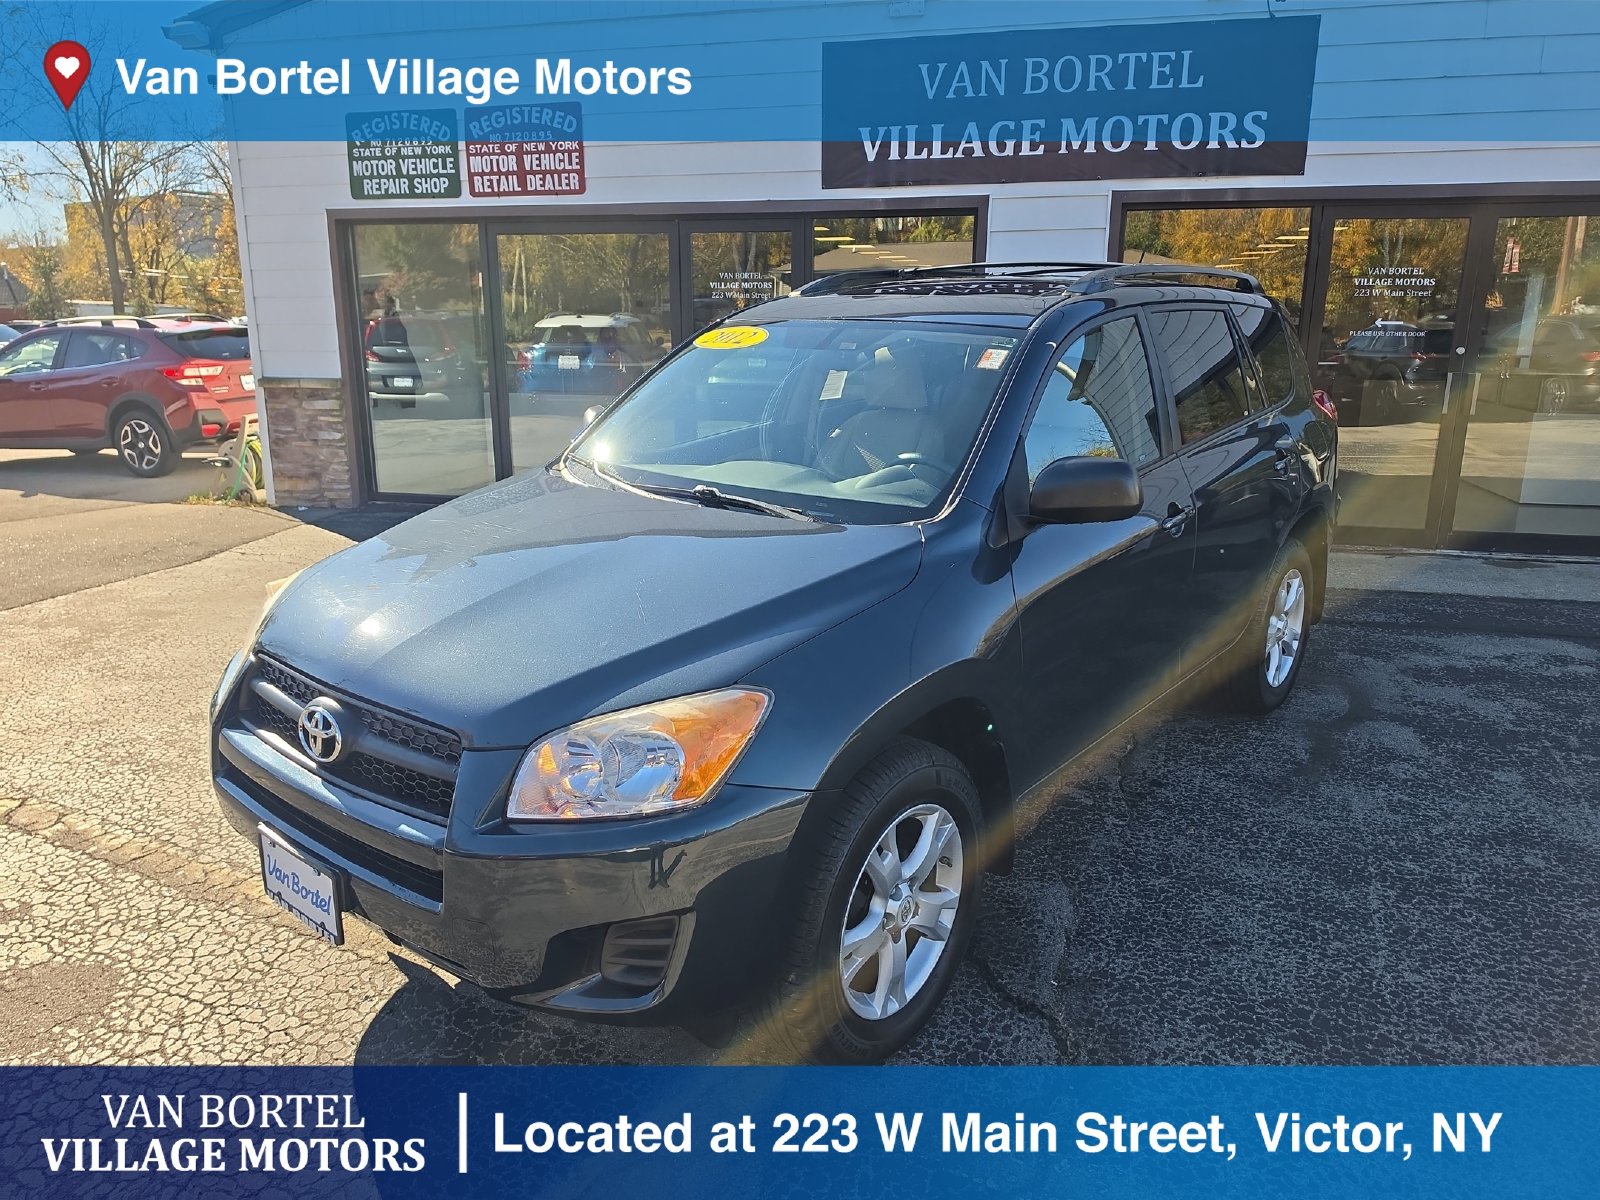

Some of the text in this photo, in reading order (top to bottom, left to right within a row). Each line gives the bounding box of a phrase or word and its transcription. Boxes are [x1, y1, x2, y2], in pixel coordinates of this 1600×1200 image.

[917, 50, 1205, 100] VAN BORTEL
[352, 112, 451, 147] REGISTERED
[469, 106, 578, 138] REGISTERED
[858, 110, 1269, 163] VILLAGE MOTORS
[352, 145, 452, 157] STATE OF NEW YORK
[469, 141, 579, 154] STATE OF NEW YORK
[352, 157, 456, 177] MOTOR VEHICLE
[469, 152, 581, 173] MOTOR VEHICLE
[363, 177, 449, 195] REPAIR SHOP
[473, 173, 579, 193] RETAIL DEALER
[719, 272, 763, 280] VAN BORTEL
[1367, 267, 1425, 275] VAN BORTEL
[709, 281, 773, 289] VILLAGE MOTORS
[1354, 278, 1436, 286] VILLAGE MOTORS
[711, 291, 771, 299] 223 W Main Street
[1354, 288, 1432, 297] 223 W Main Street
